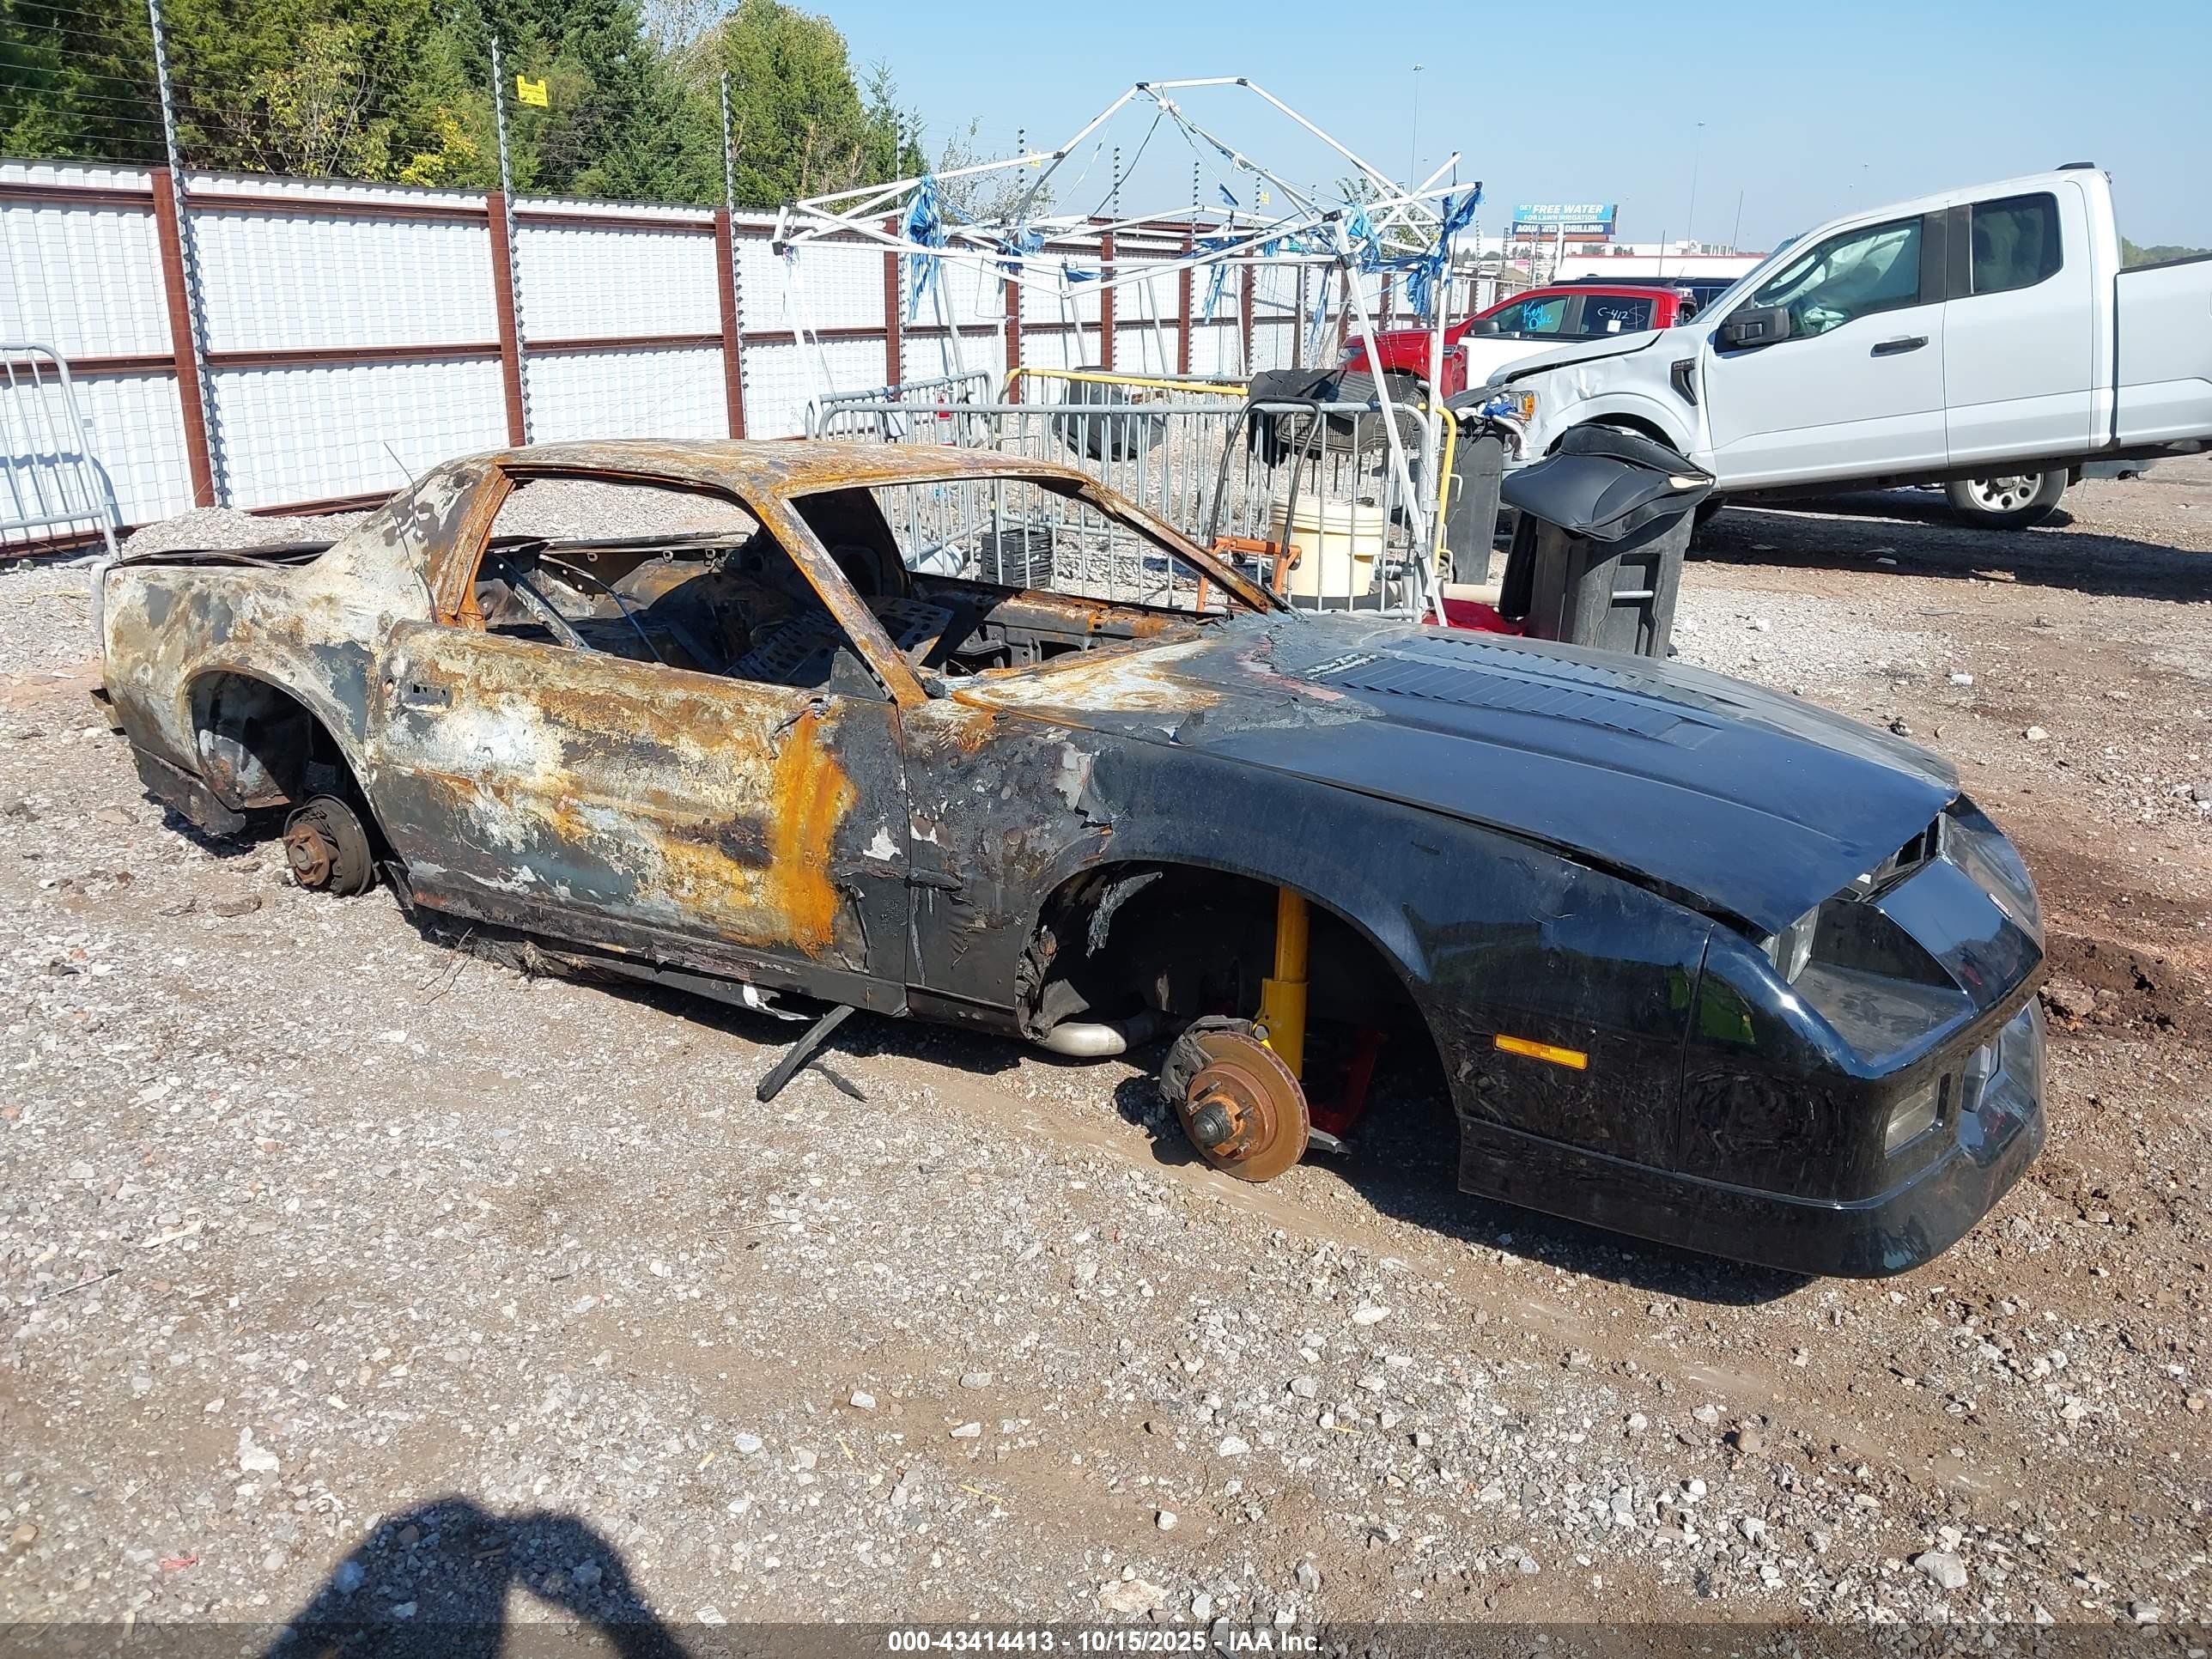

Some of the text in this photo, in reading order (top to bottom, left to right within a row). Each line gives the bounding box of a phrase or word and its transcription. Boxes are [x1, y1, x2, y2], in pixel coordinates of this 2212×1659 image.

[1533, 204, 1561, 214] FREE
[1564, 204, 1604, 214] WATER
[1565, 224, 1604, 233] DRILLING
[1597, 307, 1630, 320] C-412
